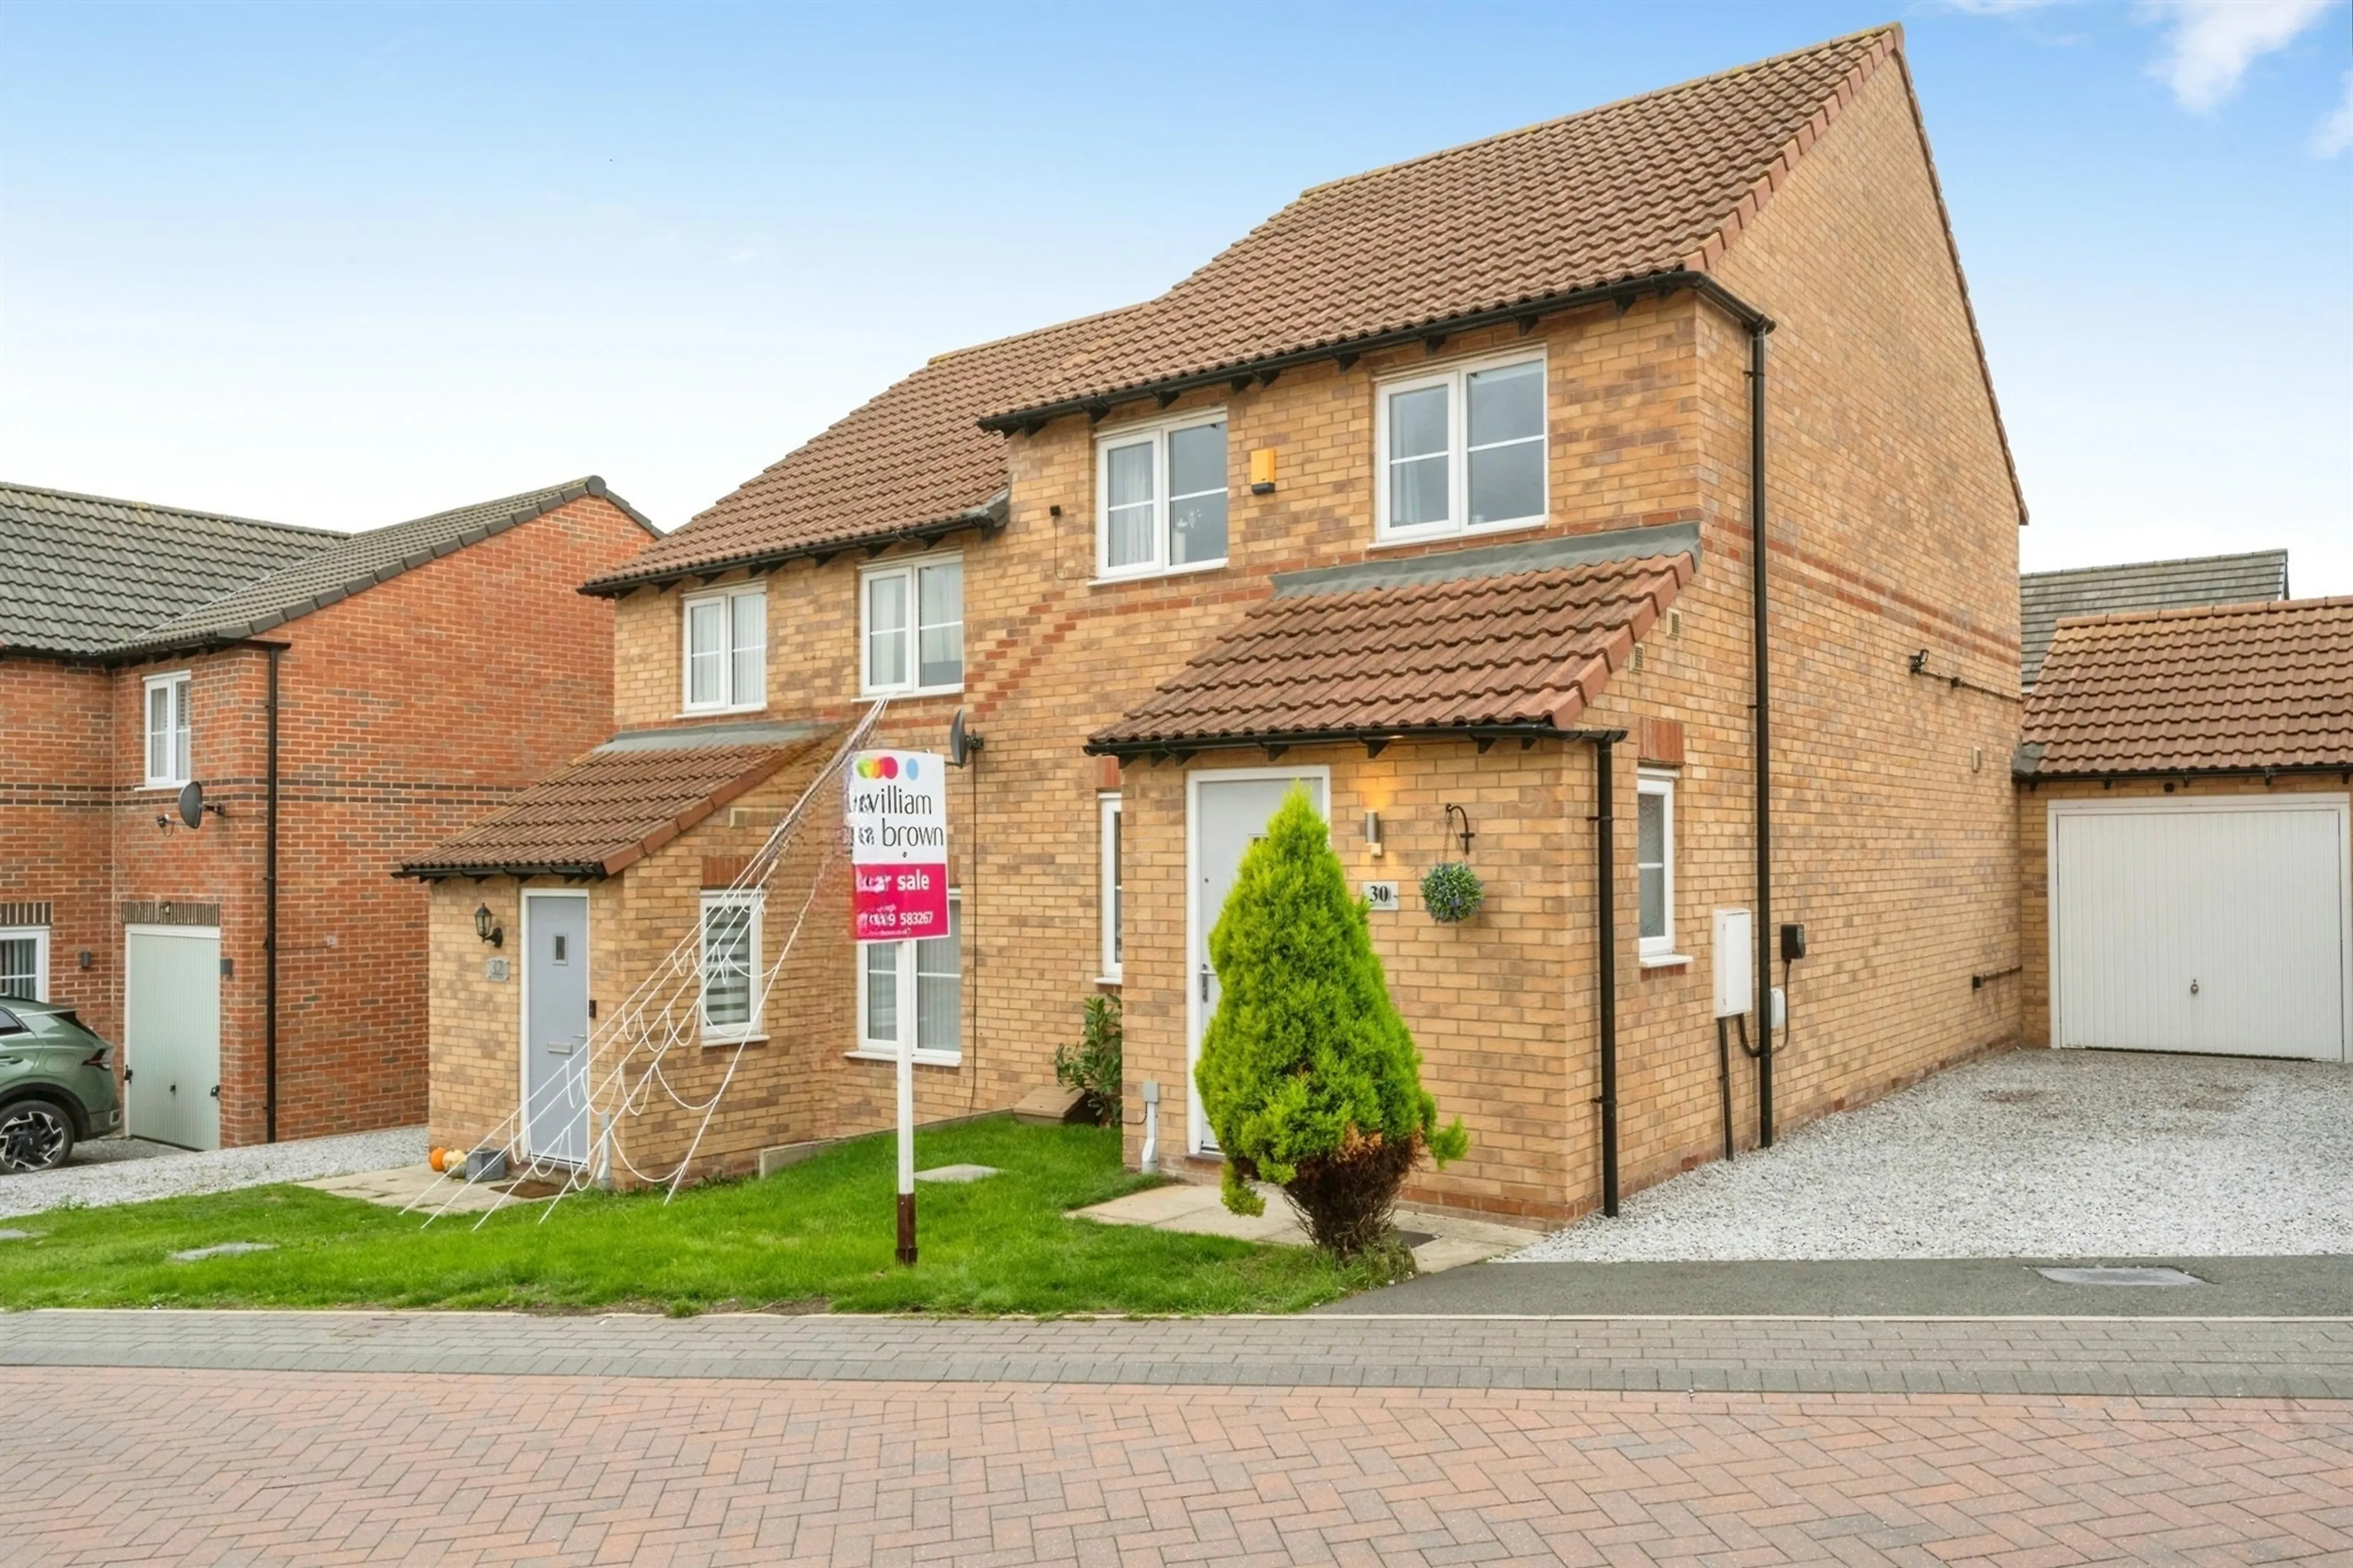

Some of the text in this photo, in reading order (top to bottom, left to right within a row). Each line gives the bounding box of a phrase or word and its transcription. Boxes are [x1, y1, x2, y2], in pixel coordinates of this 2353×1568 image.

[882, 817, 944, 847] brown
[897, 868, 930, 891] sale
[1370, 885, 1388, 902] 30
[900, 911, 933, 925] 583267
[491, 960, 503, 975] 32
